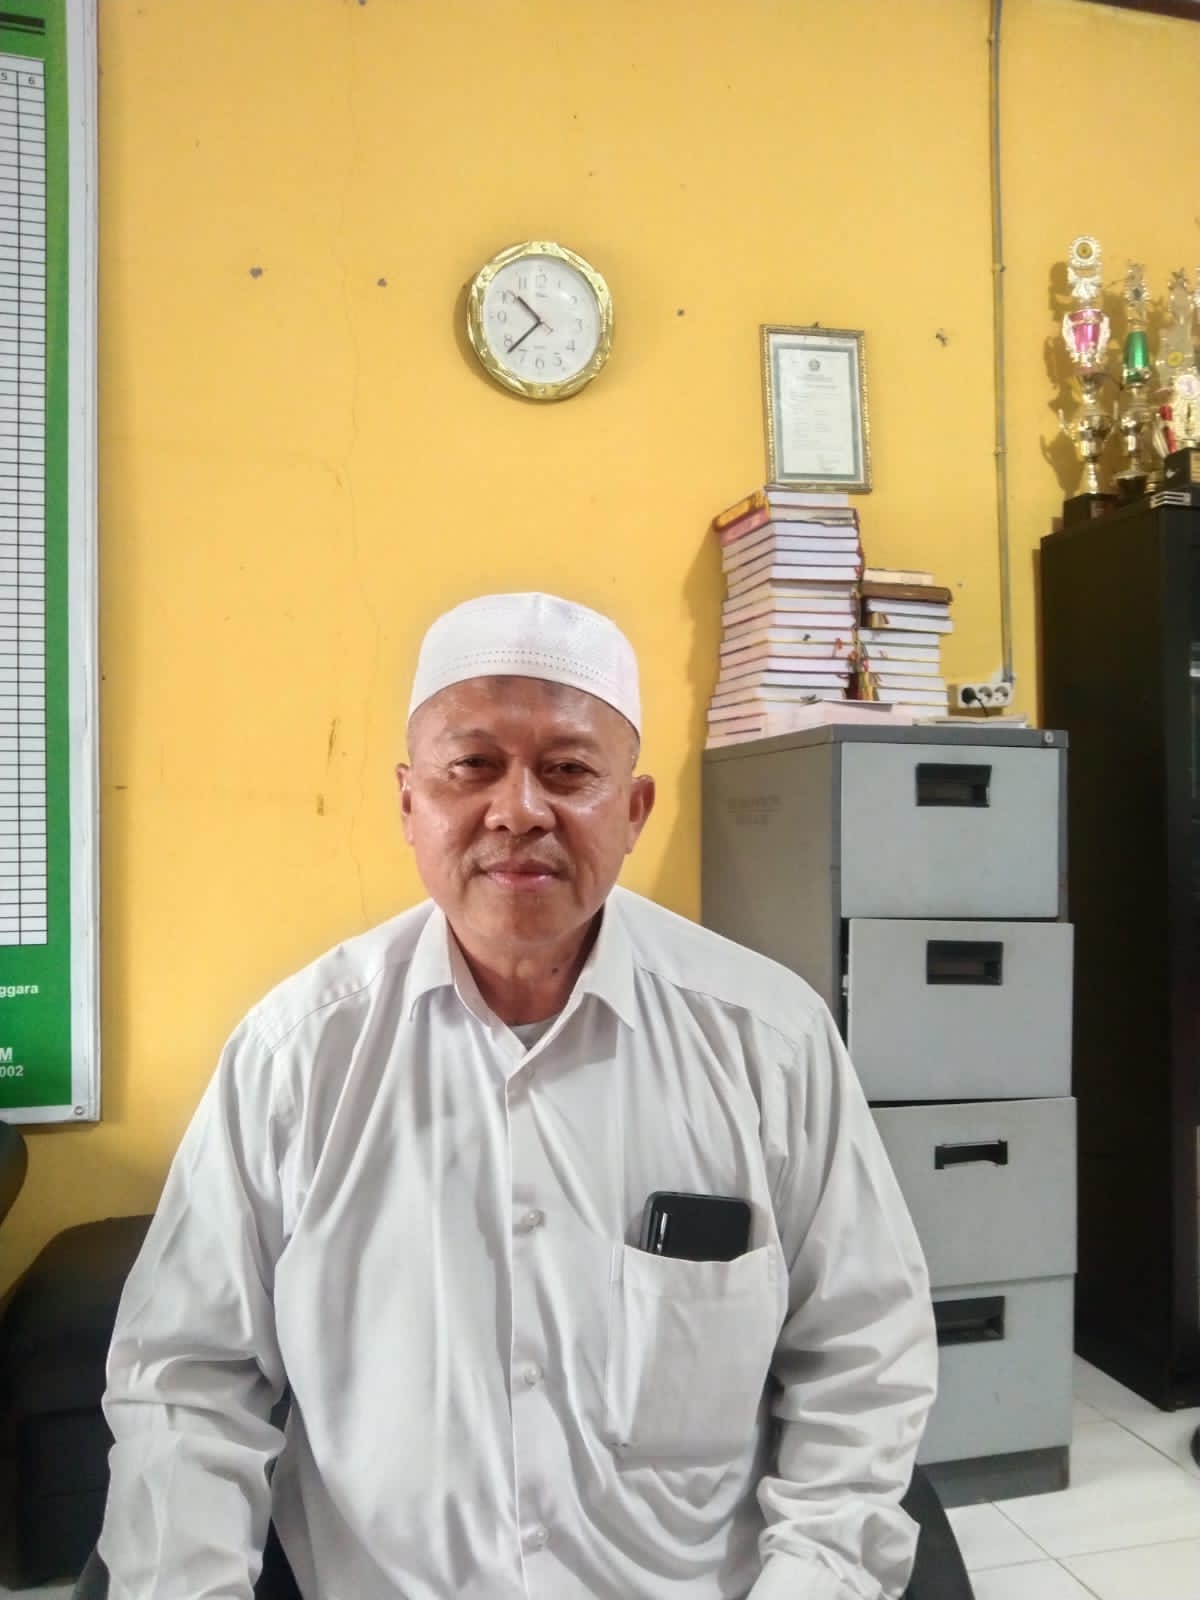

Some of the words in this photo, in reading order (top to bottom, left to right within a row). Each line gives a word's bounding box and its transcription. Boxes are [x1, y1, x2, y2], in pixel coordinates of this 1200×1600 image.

[0, 72, 8, 81] 5
[28, 76, 36, 85] 6
[518, 276, 528, 289] 11
[536, 273, 547, 289] 12
[566, 339, 576, 352] 4
[535, 355, 545, 369] 6
[552, 352, 563, 366] 5
